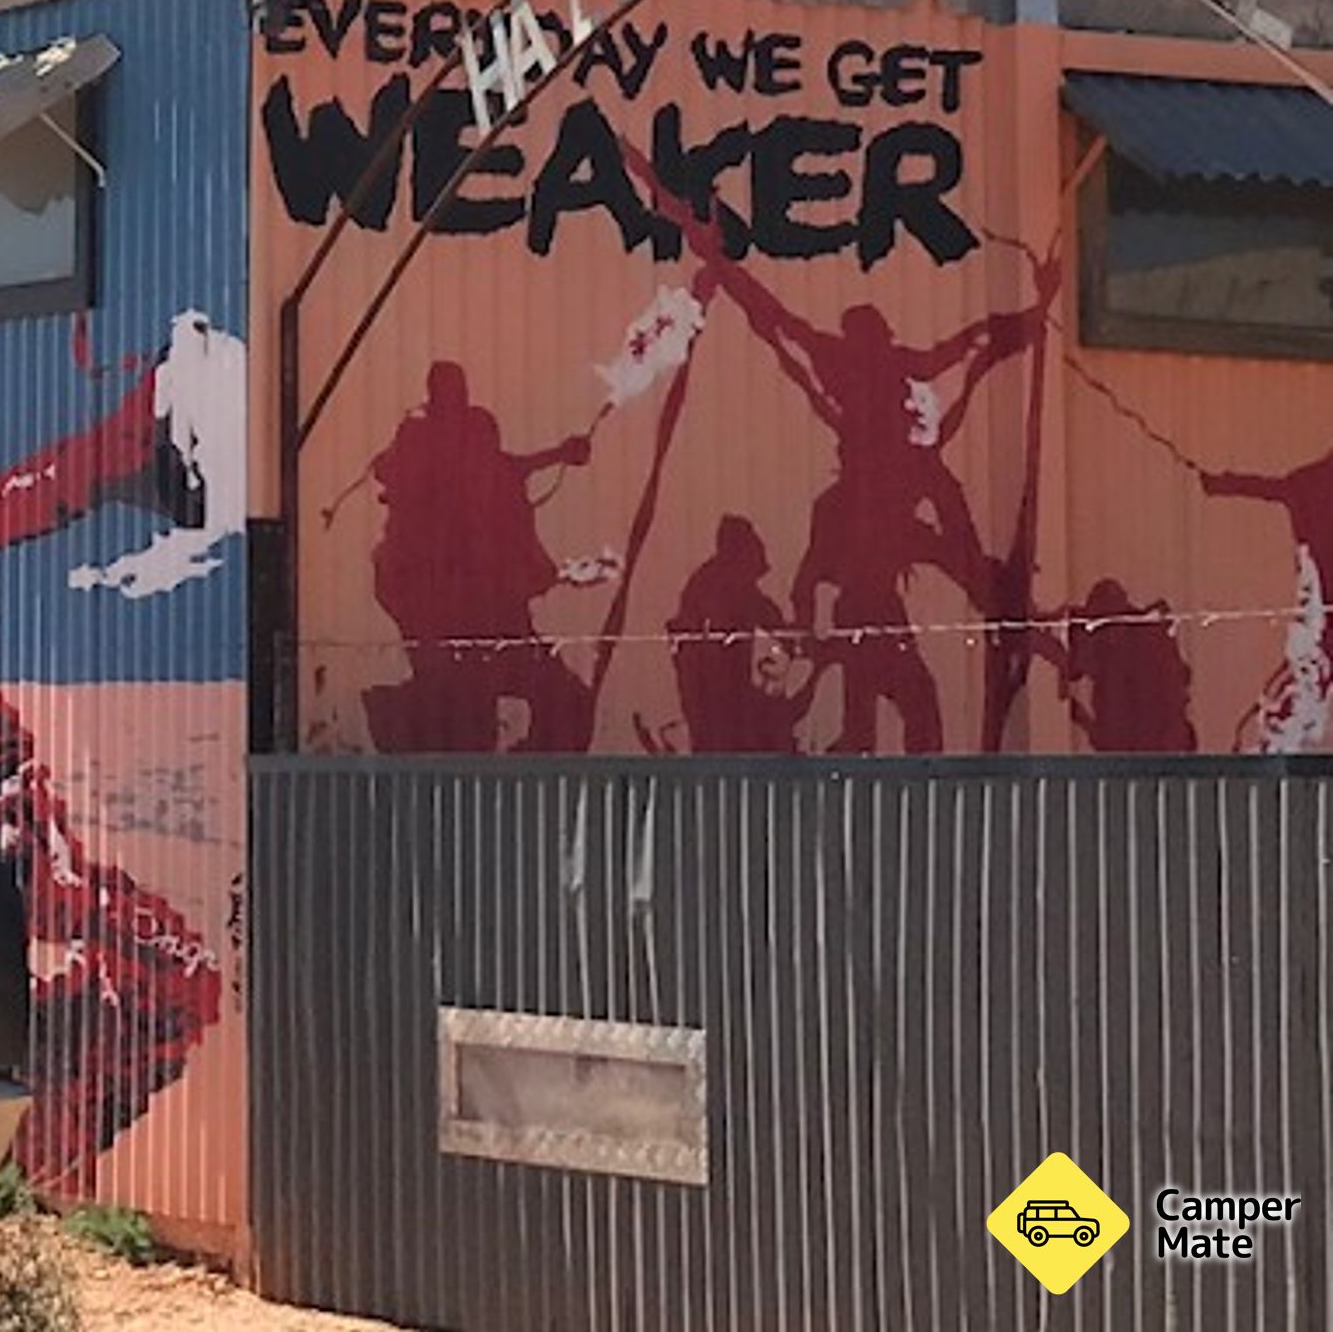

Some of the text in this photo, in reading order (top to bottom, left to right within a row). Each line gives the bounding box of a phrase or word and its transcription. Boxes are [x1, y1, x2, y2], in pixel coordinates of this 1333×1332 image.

[689, 28, 804, 98] WE
[826, 40, 983, 114] GET
[261, 71, 981, 273] WEAKER
